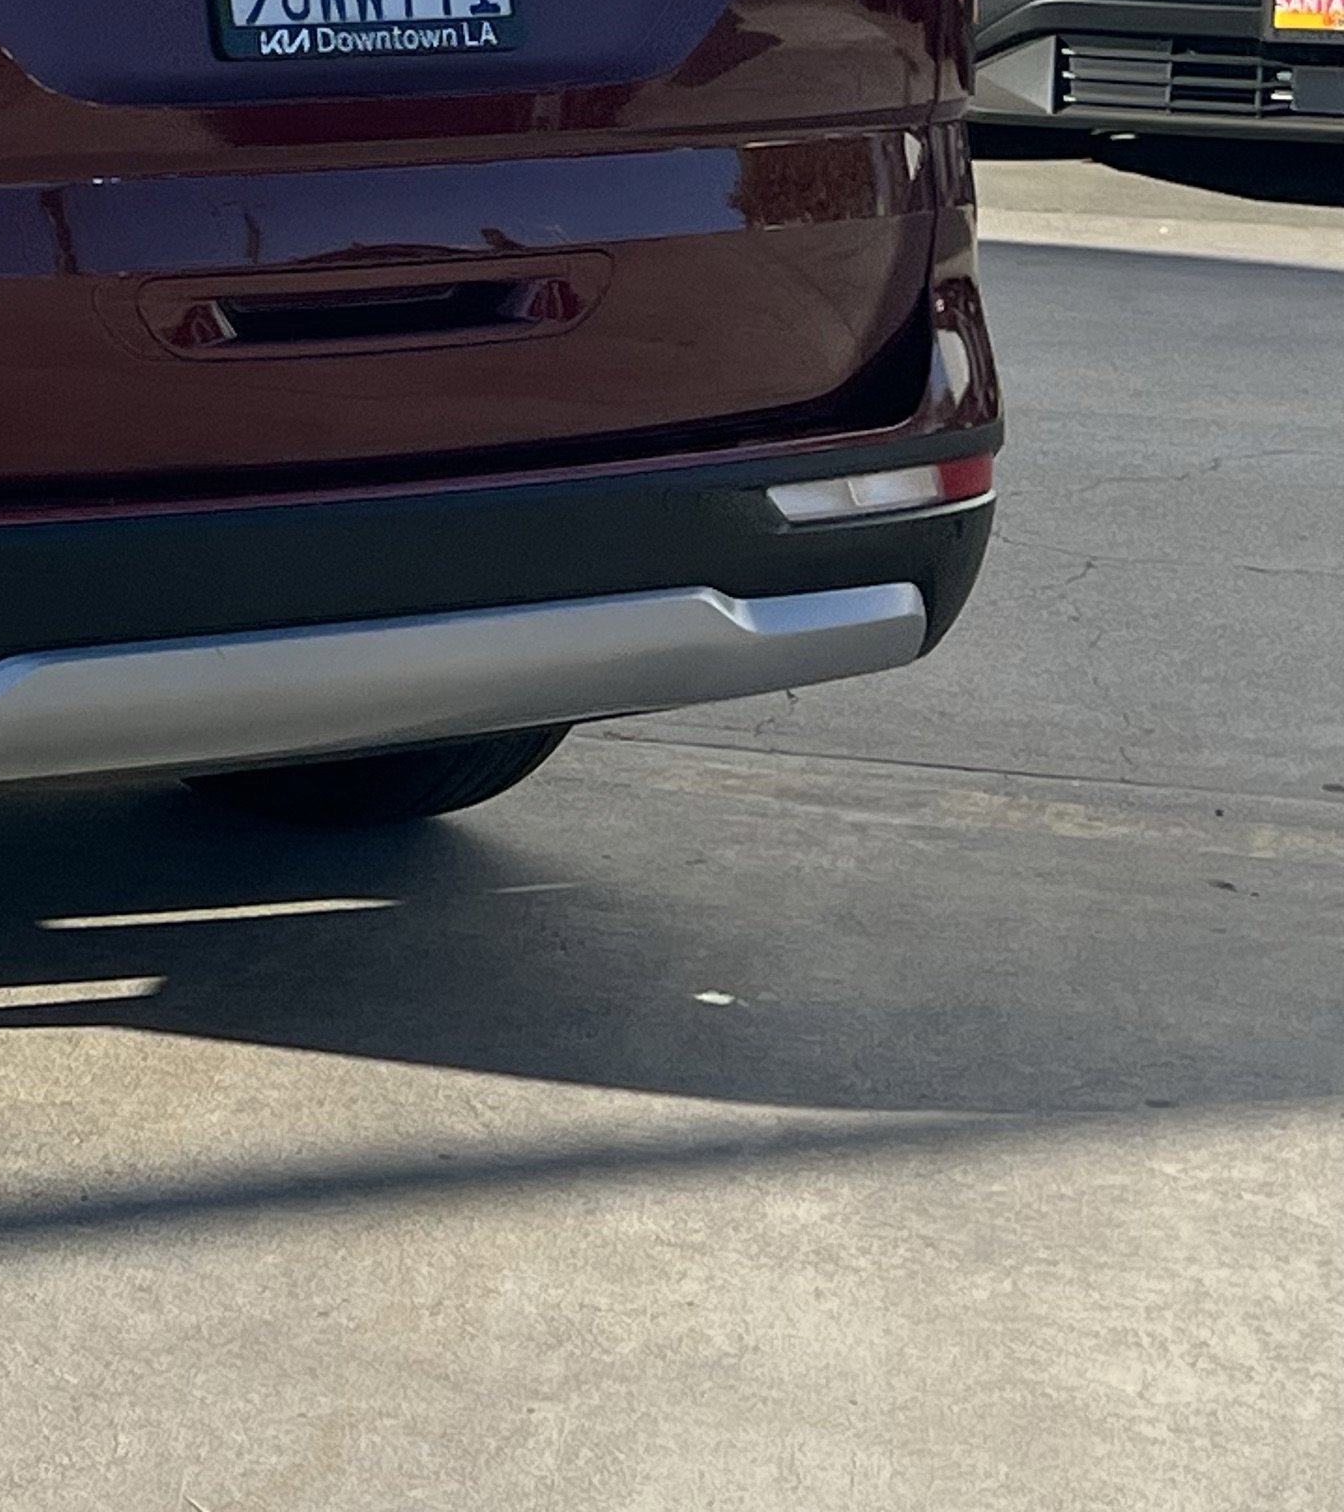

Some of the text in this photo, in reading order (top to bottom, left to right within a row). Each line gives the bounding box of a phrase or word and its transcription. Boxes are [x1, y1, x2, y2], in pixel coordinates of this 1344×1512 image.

[259, 20, 499, 56] KIA Downtown LA
